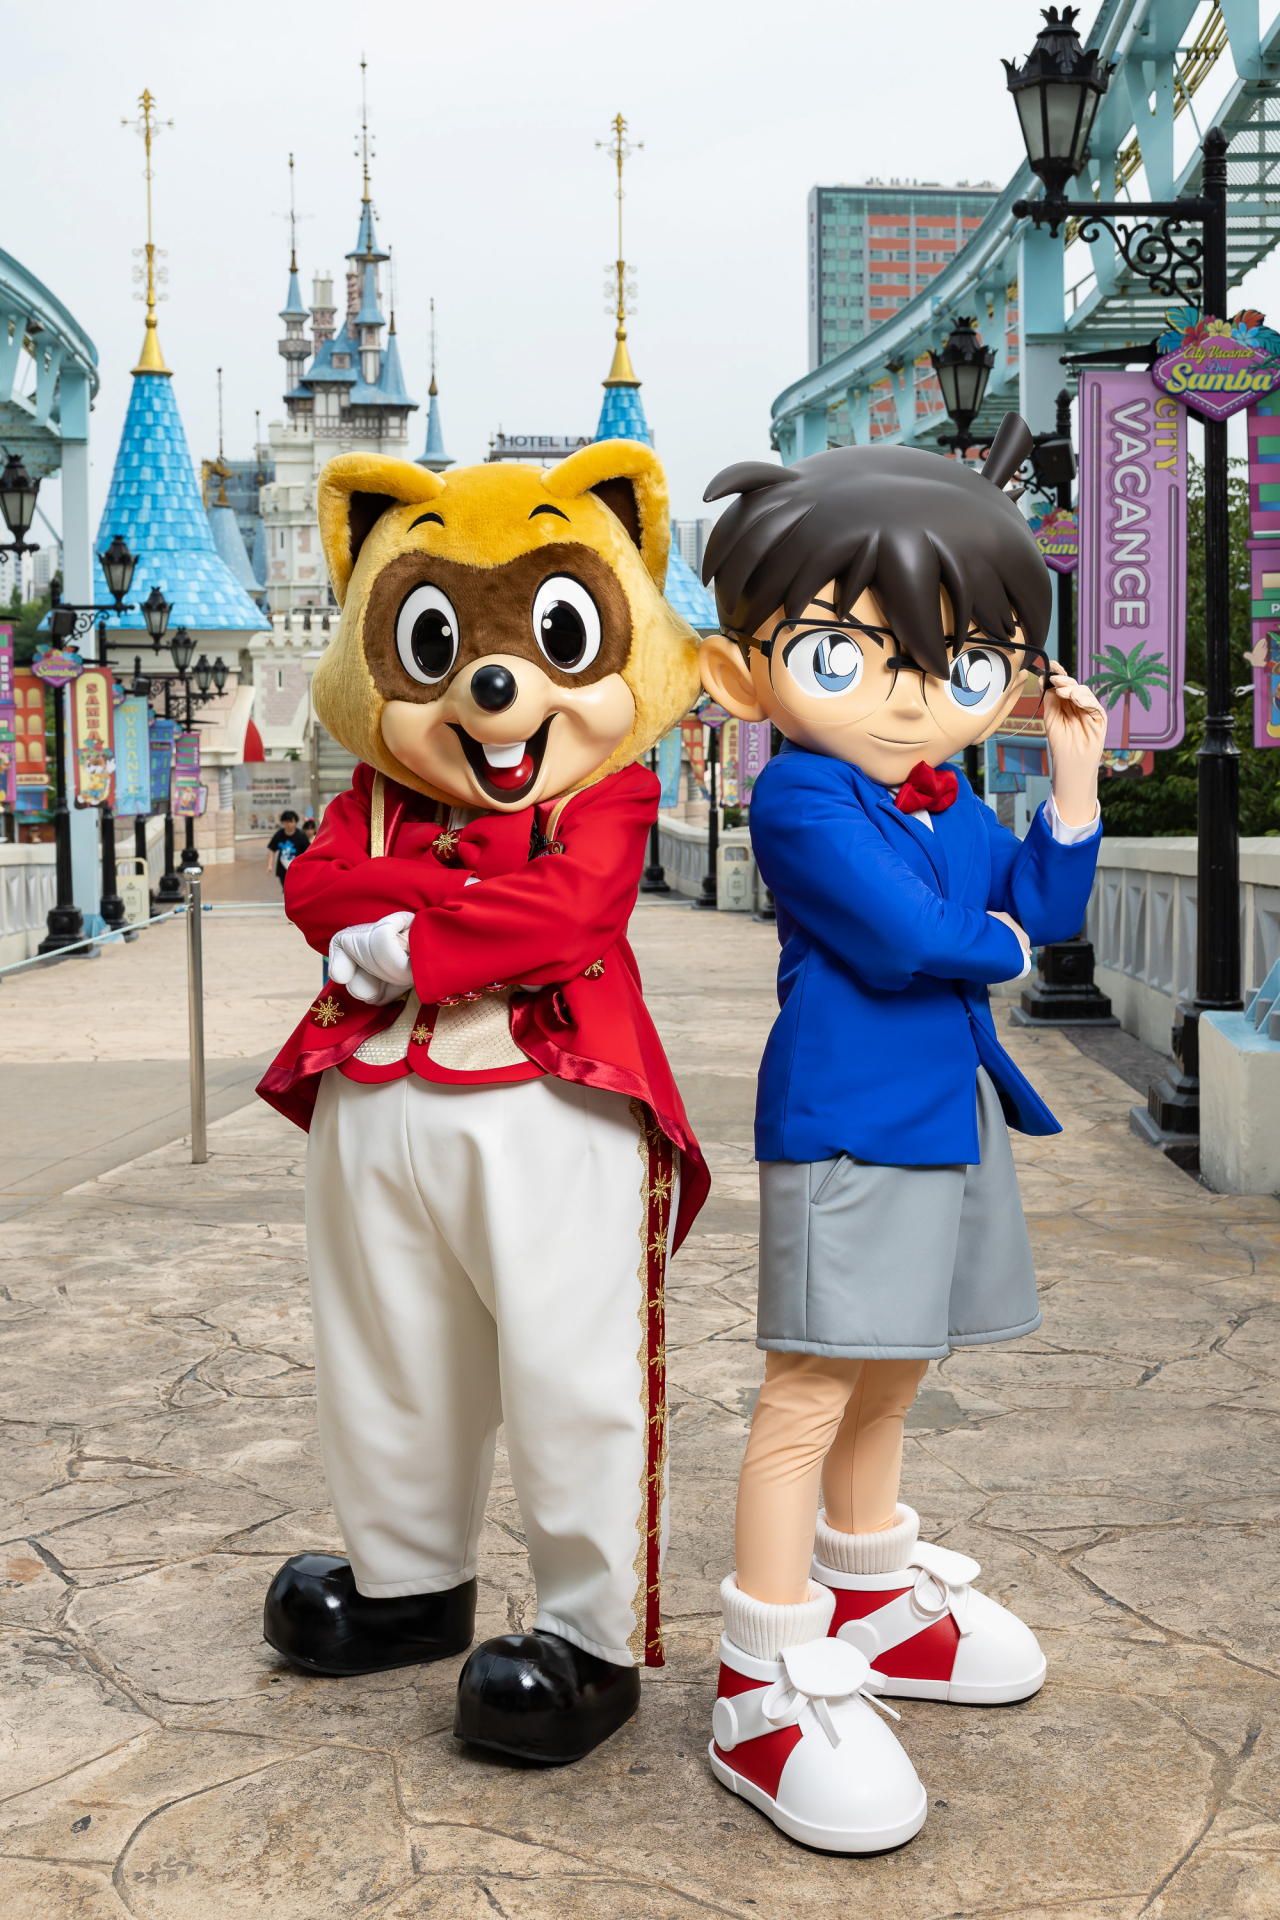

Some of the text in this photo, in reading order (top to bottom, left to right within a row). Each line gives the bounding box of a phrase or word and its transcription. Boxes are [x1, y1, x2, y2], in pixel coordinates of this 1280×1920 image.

[1183, 345, 1256, 365] City Vacance
[1205, 360, 1232, 373] And
[1165, 362, 1274, 394] Samba
[501, 435, 559, 448] HOTEL
[1154, 396, 1178, 478] CITY
[1111, 398, 1150, 628] VACANCE
[1036, 537, 1078, 555] Sam
[86, 683, 100, 741] SAMBA
[124, 716, 140, 795] VACANCE
[747, 722, 760, 770] CANCE
